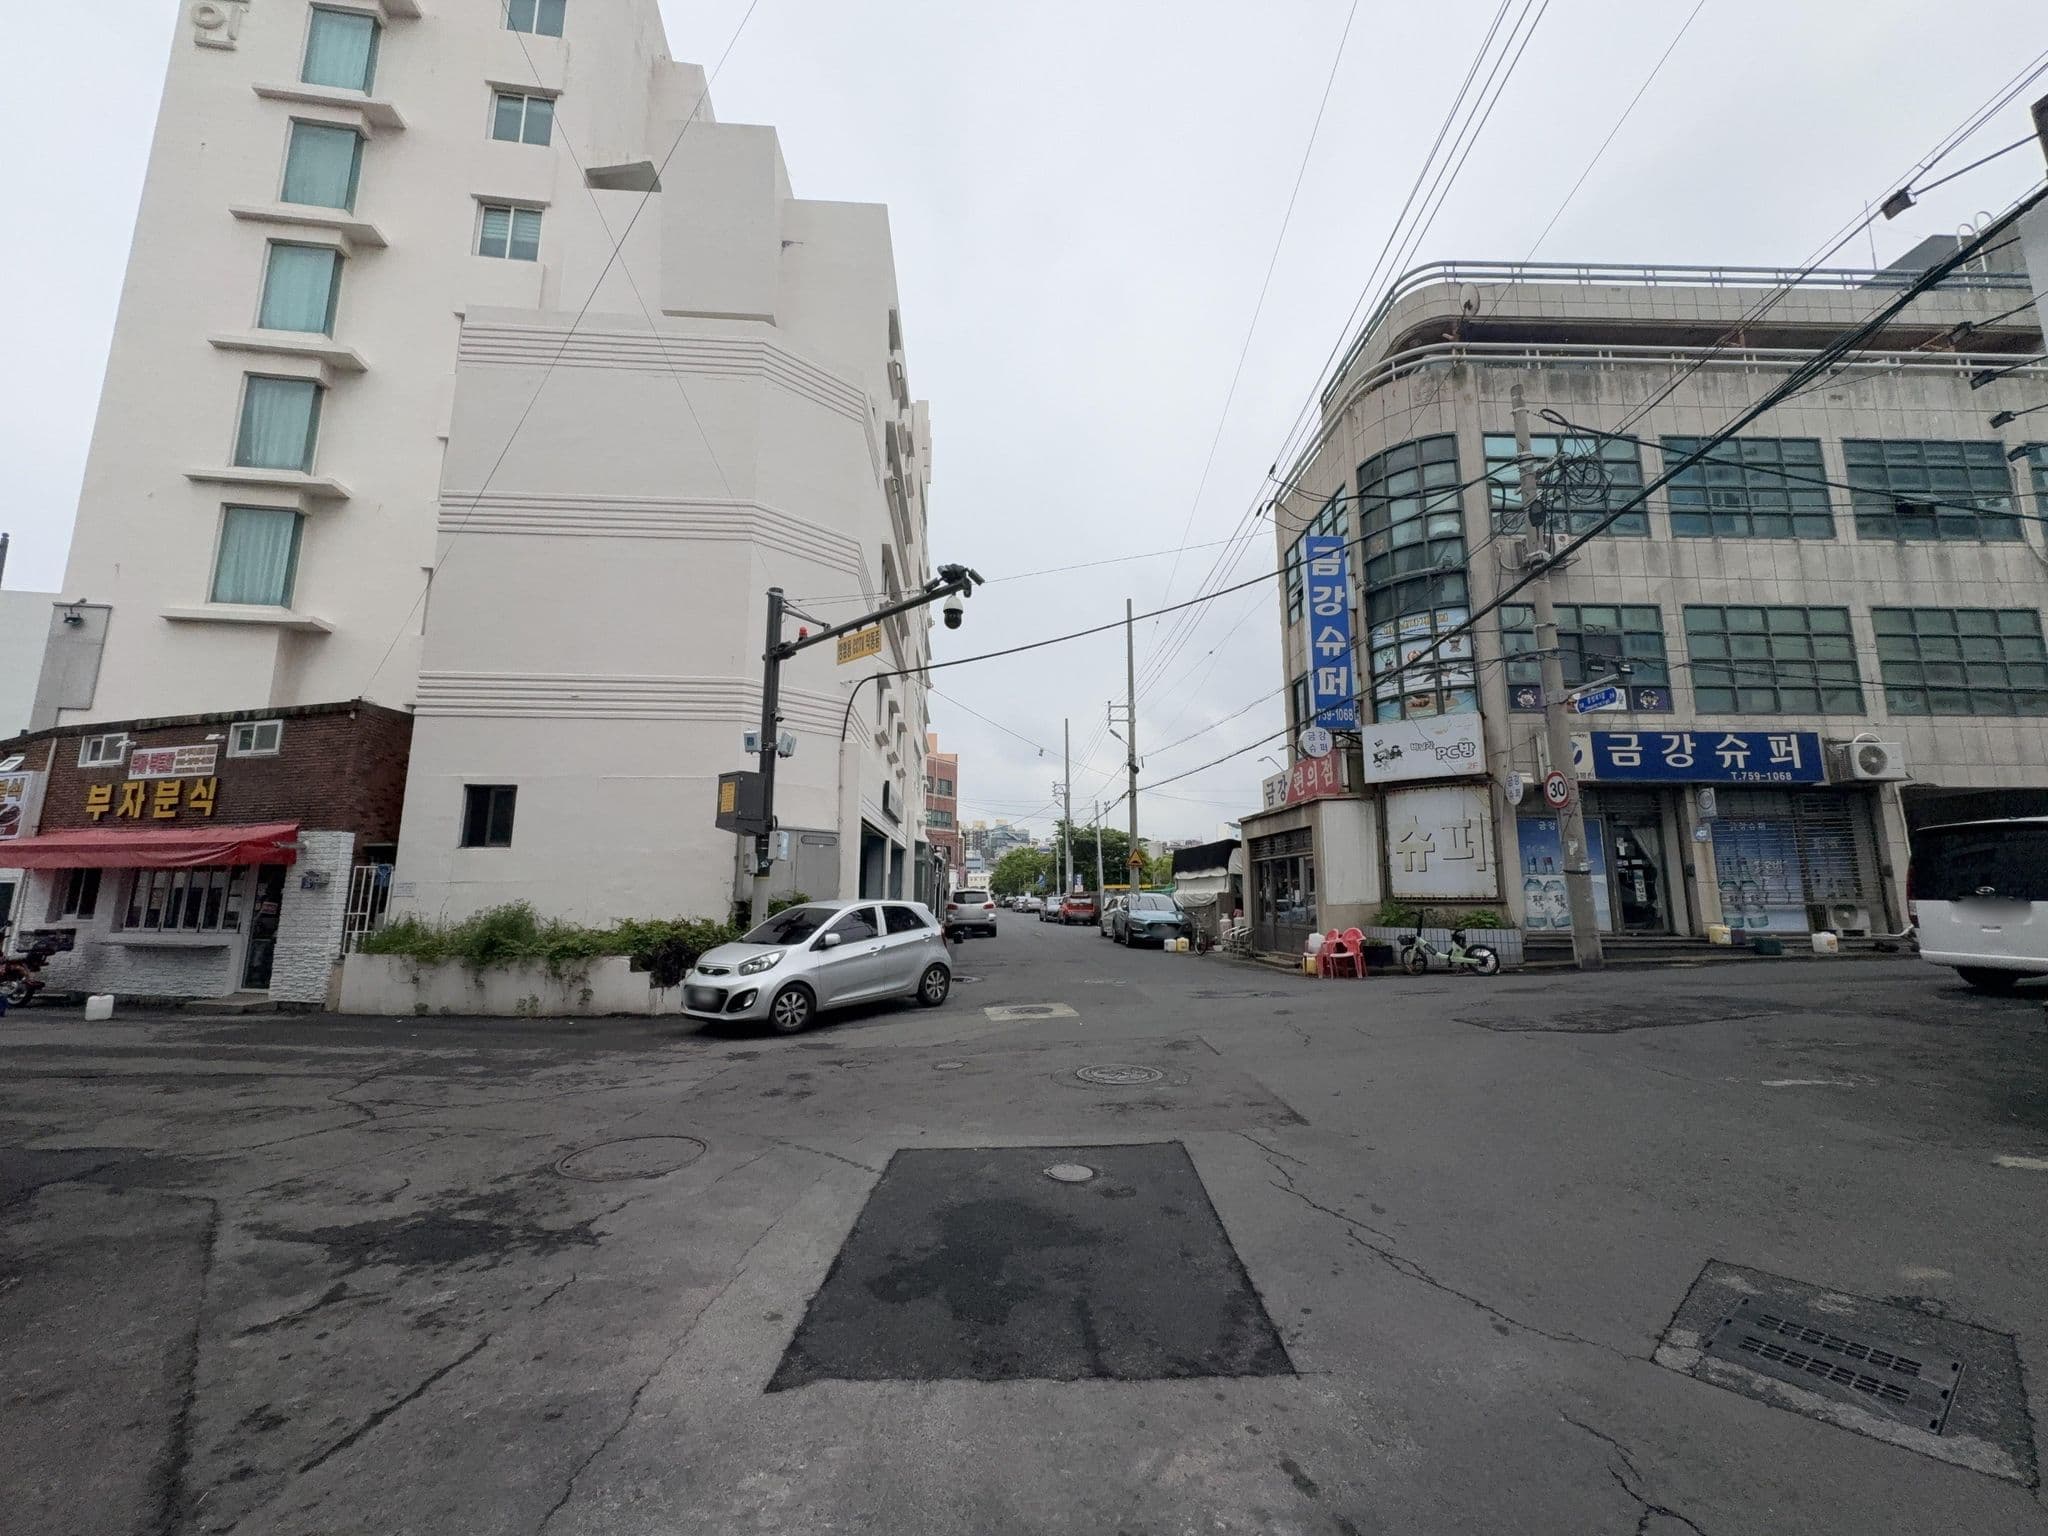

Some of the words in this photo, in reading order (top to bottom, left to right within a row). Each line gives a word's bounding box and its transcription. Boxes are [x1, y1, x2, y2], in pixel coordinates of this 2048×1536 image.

[1311, 546, 1348, 697] 금강슈퍼
[1308, 731, 1327, 742] 금강
[1309, 743, 1328, 753] 슈퍼
[1435, 741, 1476, 761] PC방
[1607, 733, 1802, 769] 금강슈퍼
[1265, 774, 1288, 807] 금강
[1293, 755, 1334, 796] 편의점
[1550, 781, 1566, 798] 30
[1730, 771, 1793, 781] T.759-1068
[86, 776, 218, 821] 부자분식
[1396, 813, 1487, 873] 슈퍼
